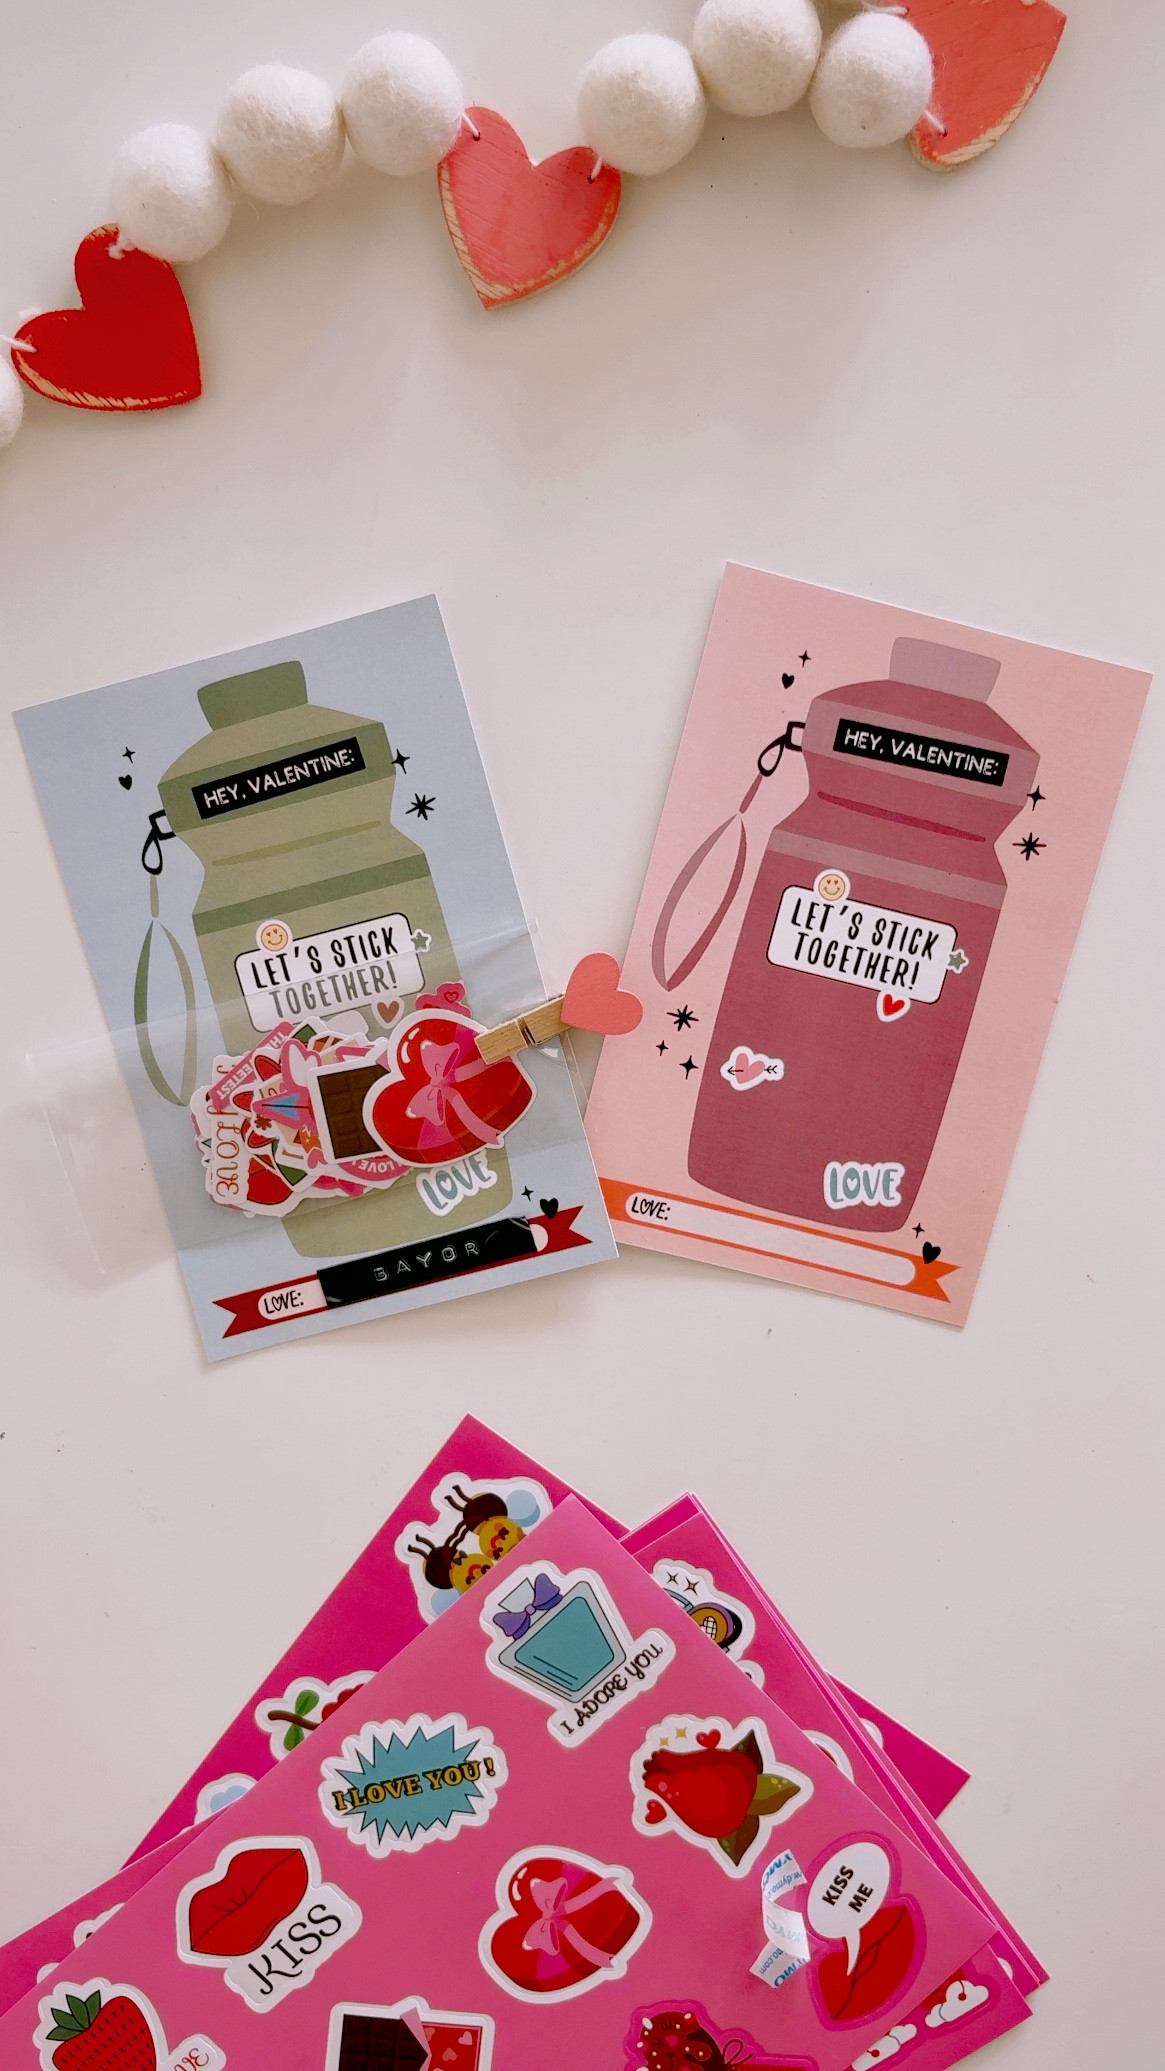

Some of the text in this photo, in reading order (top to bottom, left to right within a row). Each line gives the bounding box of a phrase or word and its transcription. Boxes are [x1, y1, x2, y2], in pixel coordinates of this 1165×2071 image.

[844, 728, 999, 776] HEY, VALENTINE:
[203, 749, 355, 808] HEY, VALENTINE:
[791, 898, 940, 961] LET'S STICK
[251, 926, 399, 989] LET'S STICK
[794, 932, 920, 990] TOGETHER!
[269, 960, 398, 1018] TOGETHER!
[217, 1062, 255, 1100] EETEST
[422, 1151, 491, 1209] LOVE
[830, 1166, 898, 1203] LOVE
[631, 1196, 671, 1221] LOVE:
[373, 1240, 480, 1282] BAYOR
[264, 1290, 305, 1314] LOVE:
[560, 1720, 575, 1735] I
[574, 1673, 628, 1727] ADORE
[332, 1791, 348, 1811] I
[349, 1774, 423, 1808] LOVE
[822, 1865, 854, 1906] KISS
[848, 1883, 874, 1913] ME
[248, 1904, 342, 1995] KISS
